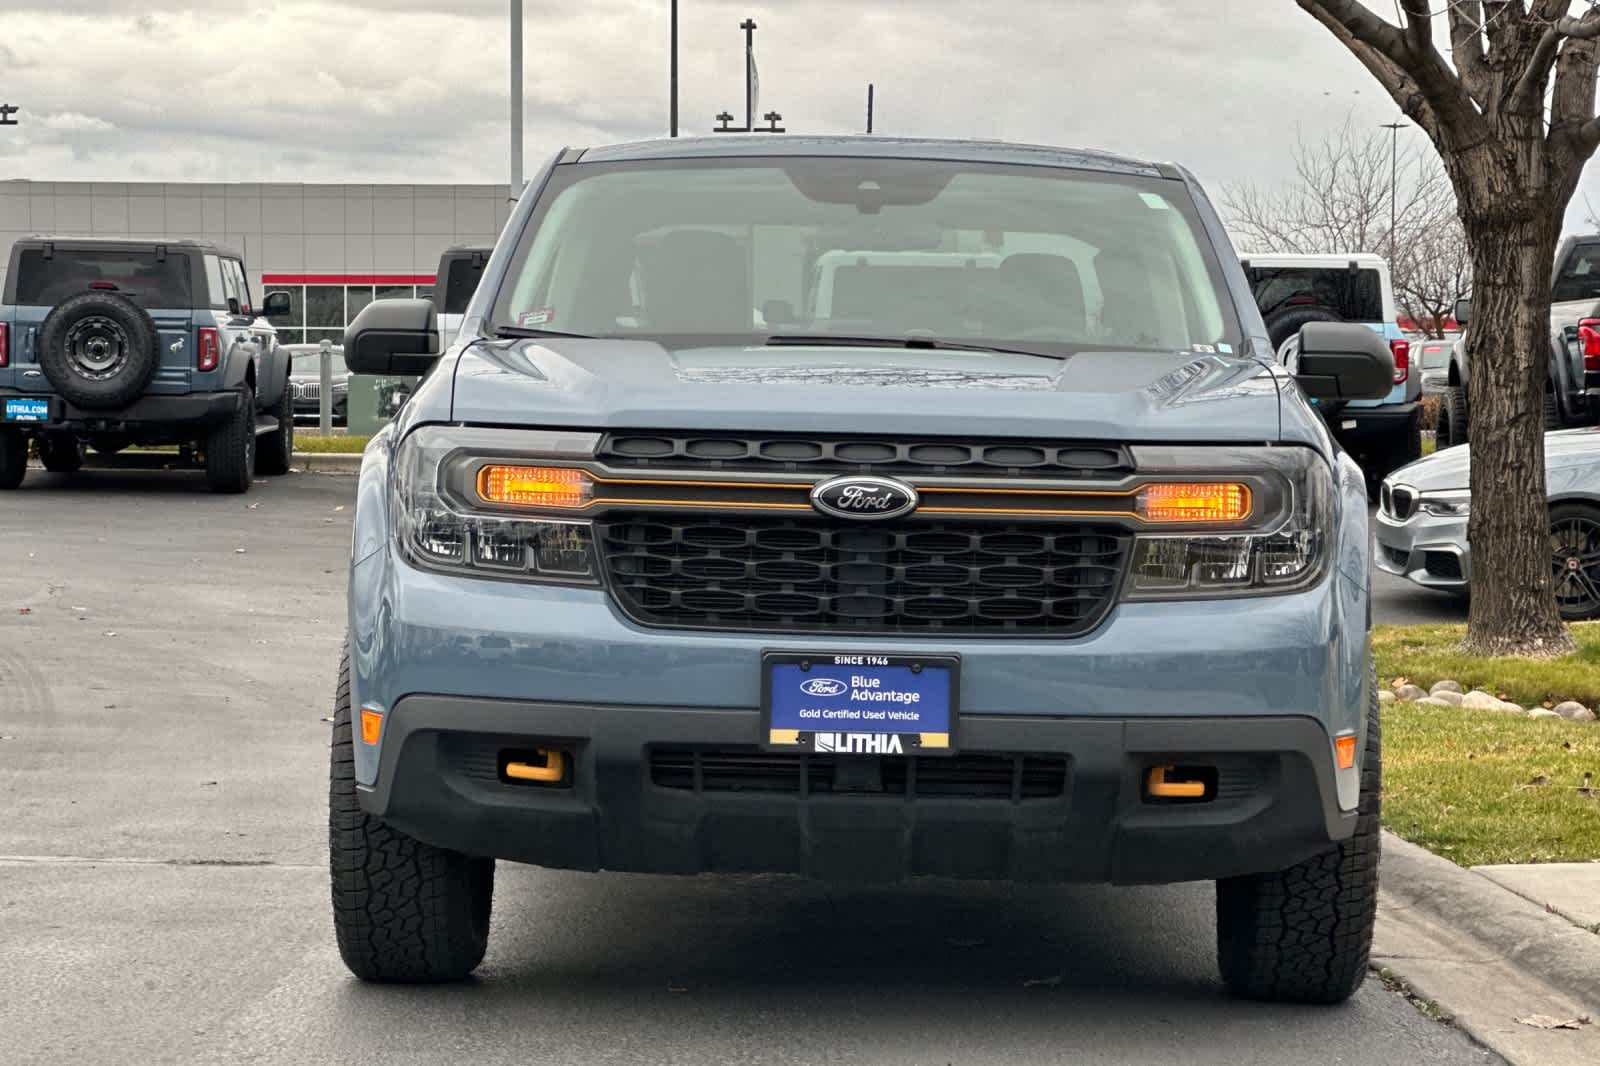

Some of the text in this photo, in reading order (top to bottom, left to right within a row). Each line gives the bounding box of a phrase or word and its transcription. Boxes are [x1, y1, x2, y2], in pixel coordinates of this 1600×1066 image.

[837, 485, 893, 509] Ford
[834, 656, 889, 666] SINCE 1946
[808, 680, 839, 694] Ford
[851, 676, 880, 688] Blue
[851, 689, 920, 704] Advantage
[799, 709, 920, 721] Gold Certified Used Vehicle
[835, 733, 903, 754] LITHIA
